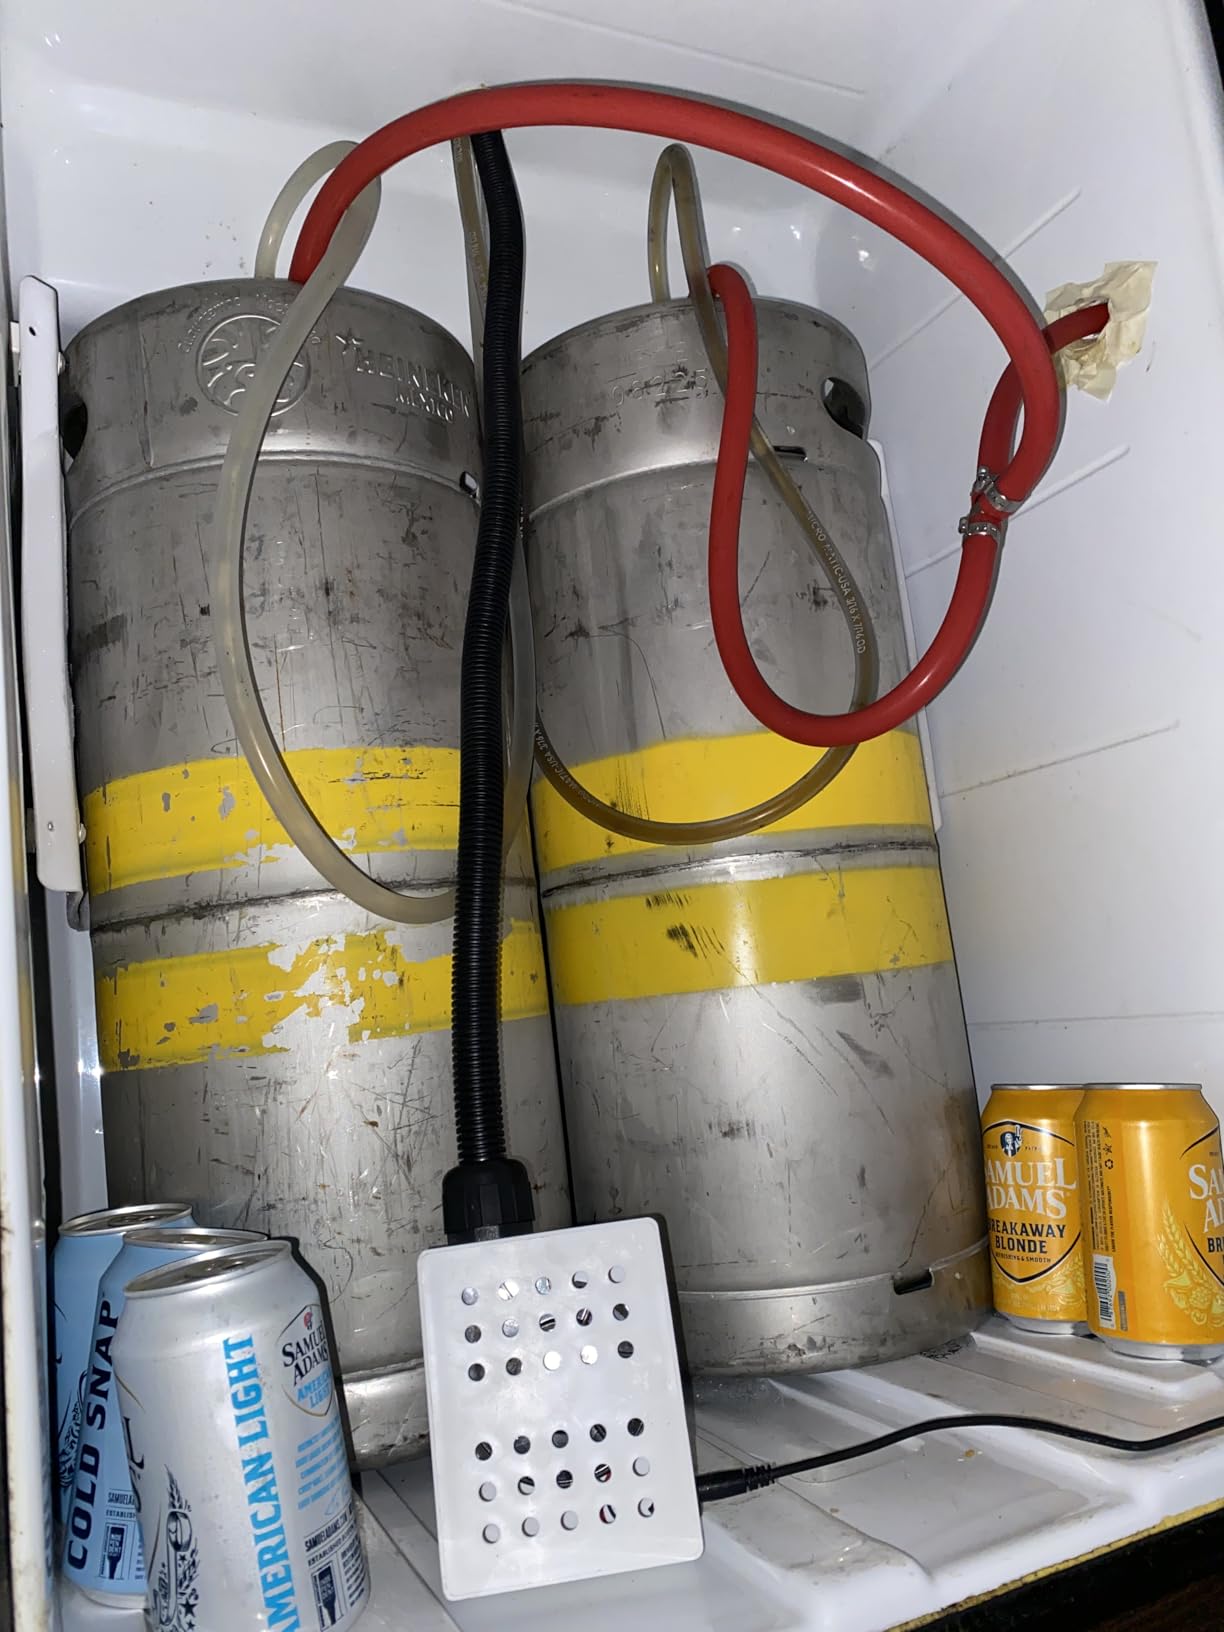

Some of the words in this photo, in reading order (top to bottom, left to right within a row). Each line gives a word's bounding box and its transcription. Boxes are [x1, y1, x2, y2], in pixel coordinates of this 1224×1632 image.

[984, 1156, 1077, 1190] AMUEL
[990, 1218, 1067, 1239] REAKAWAY
[995, 1235, 1048, 1254] BLONDE
[1026, 1256, 1052, 1264] SMOOTH
[293, 1345, 329, 1388] ADAMS
[222, 1333, 270, 1449] LIGHT
[67, 1443, 101, 1570] COLD
[86, 1300, 120, 1431] SNAP
